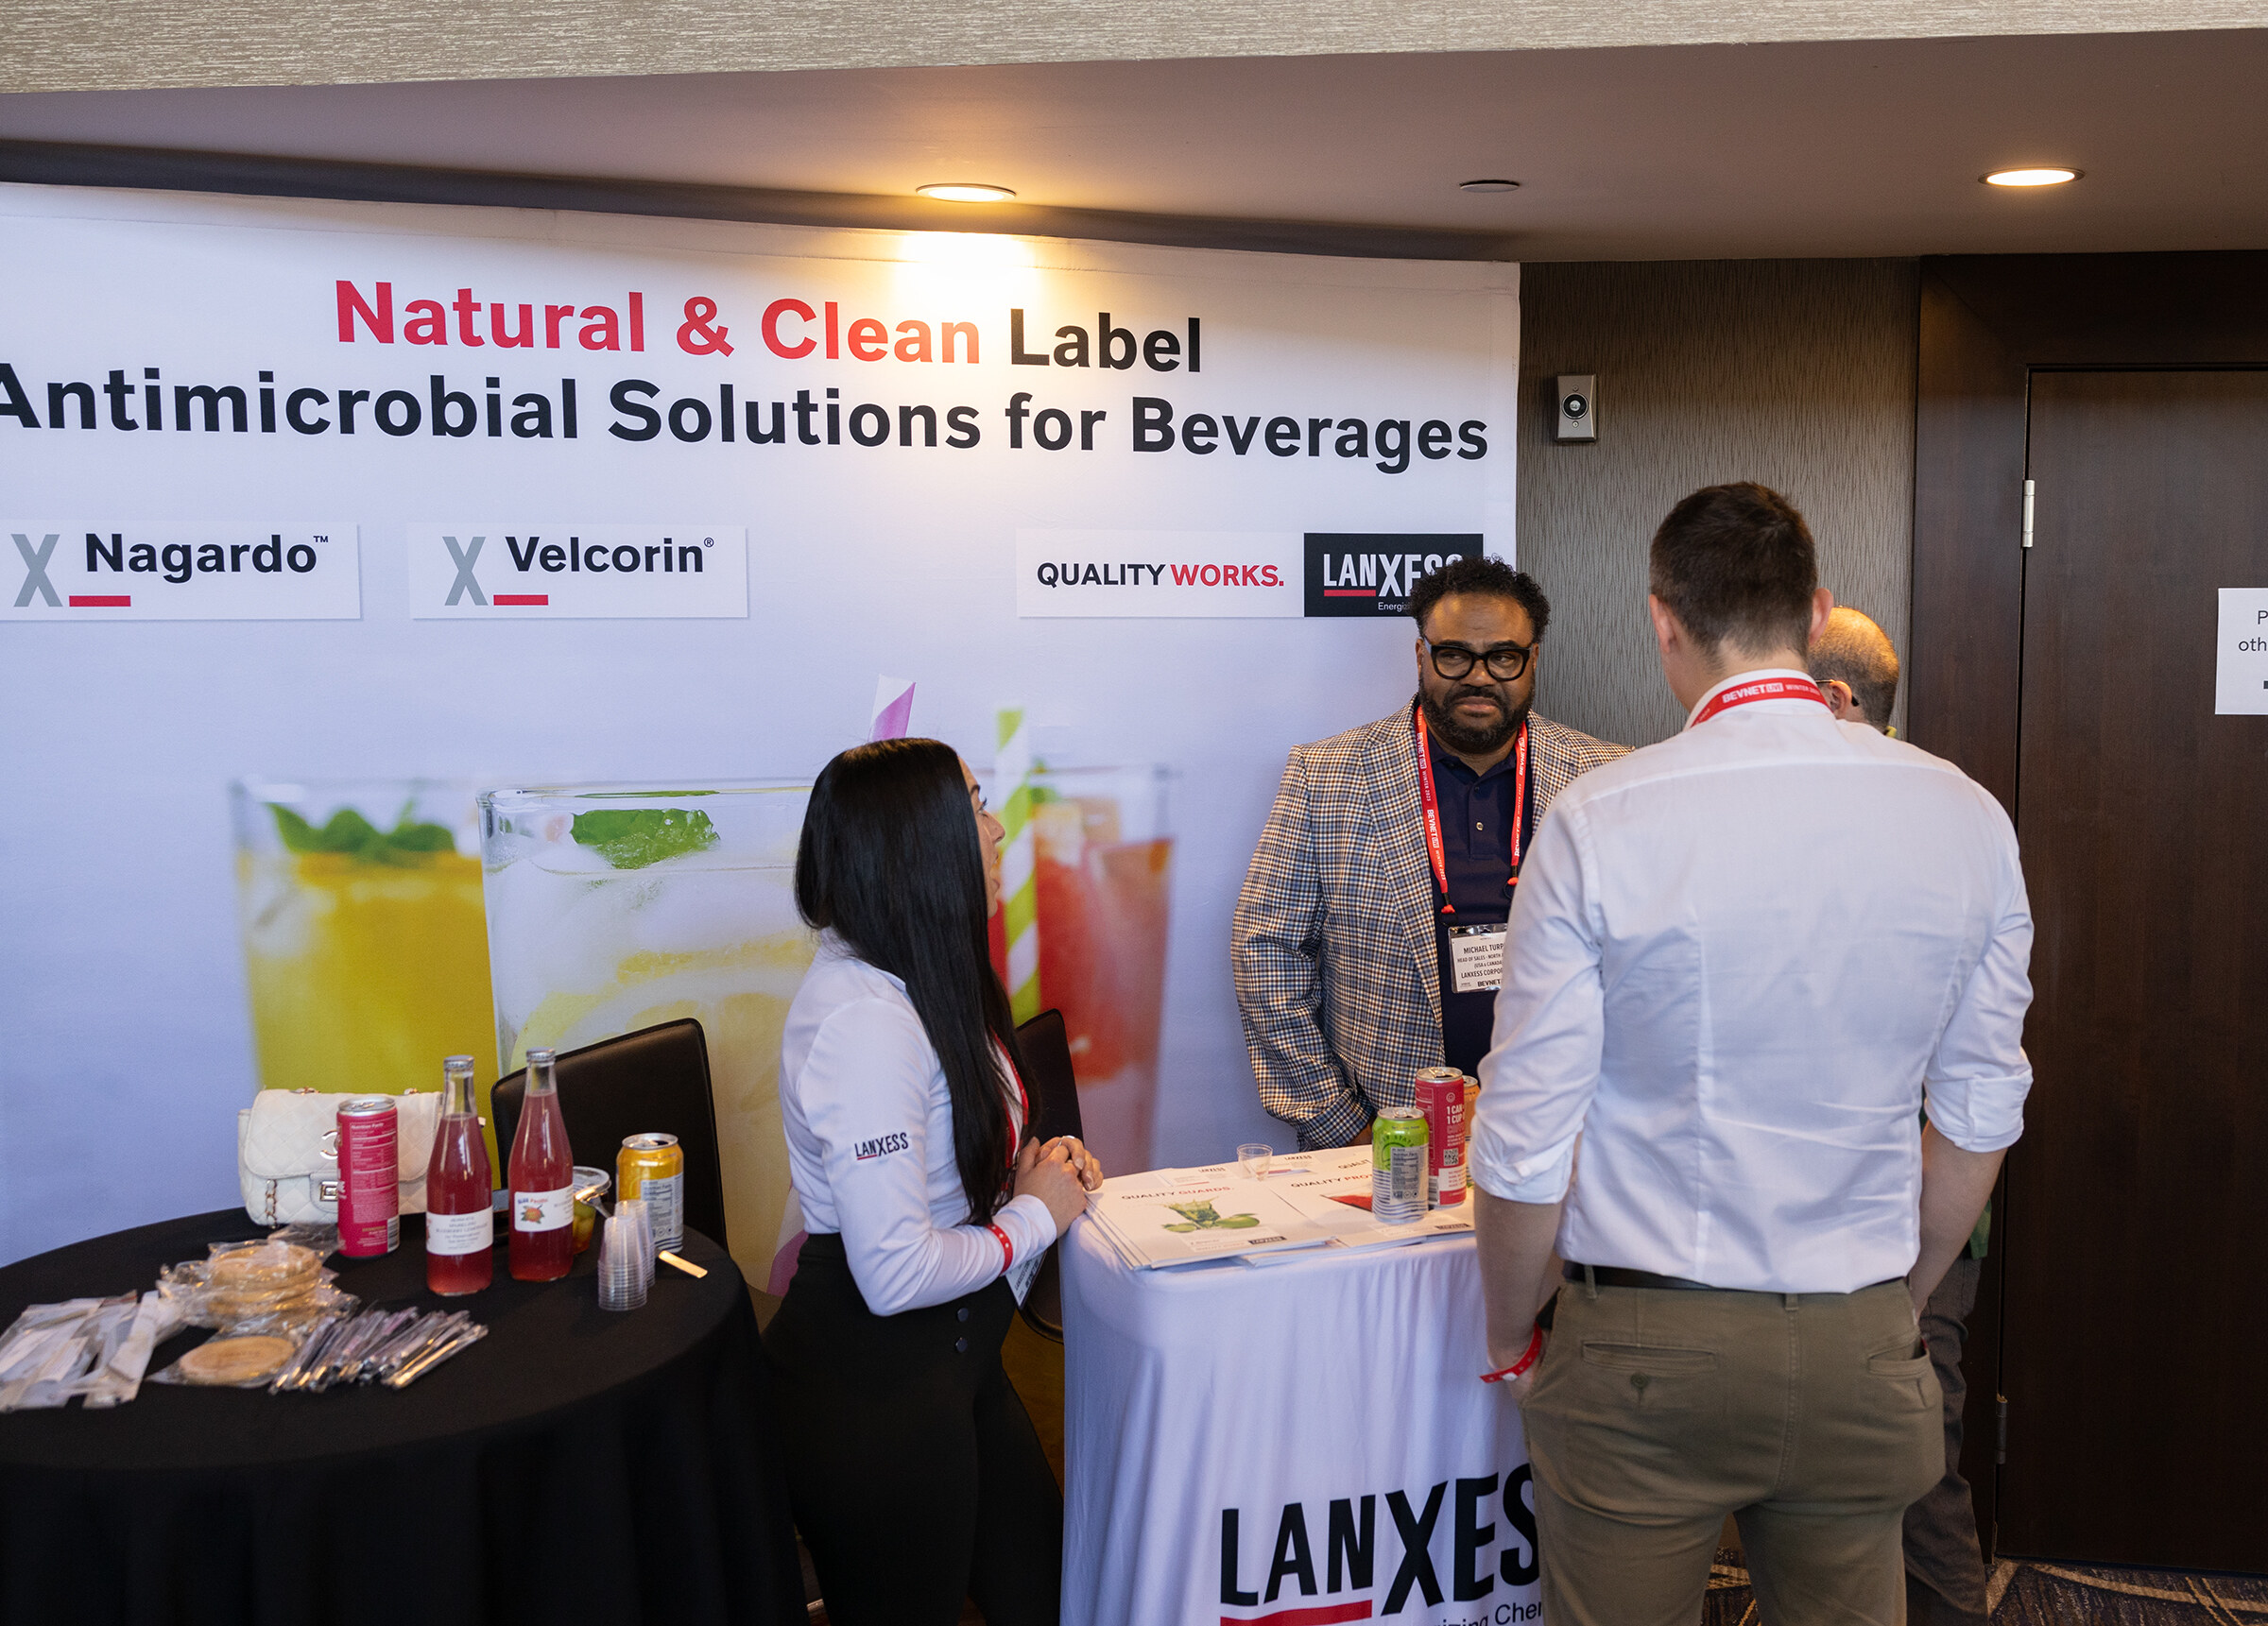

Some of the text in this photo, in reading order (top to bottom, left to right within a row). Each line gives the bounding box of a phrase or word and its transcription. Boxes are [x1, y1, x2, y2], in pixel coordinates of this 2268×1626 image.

[335, 280, 1201, 373] Natural & Clean Label
[0, 363, 1488, 474] Antimicrobial Solutions for Beverages
[1037, 562, 1285, 589] QUALITY WORKS.
[1323, 554, 1464, 597] LANXE
[1722, 684, 1766, 704] BEVNET
[1418, 731, 1426, 758] BEVNET
[1427, 809, 1438, 837] BEVNET
[1463, 945, 1488, 954] MICHAEL
[1461, 969, 1483, 979] LANXESS
[1477, 979, 1501, 987] BEVNET
[1447, 1105, 1452, 1115] 1
[1447, 1116, 1452, 1124] 1
[854, 1132, 909, 1158] LANXESS
[1291, 1177, 1341, 1188] QUALITY
[1122, 1191, 1175, 1200] QUALITY
